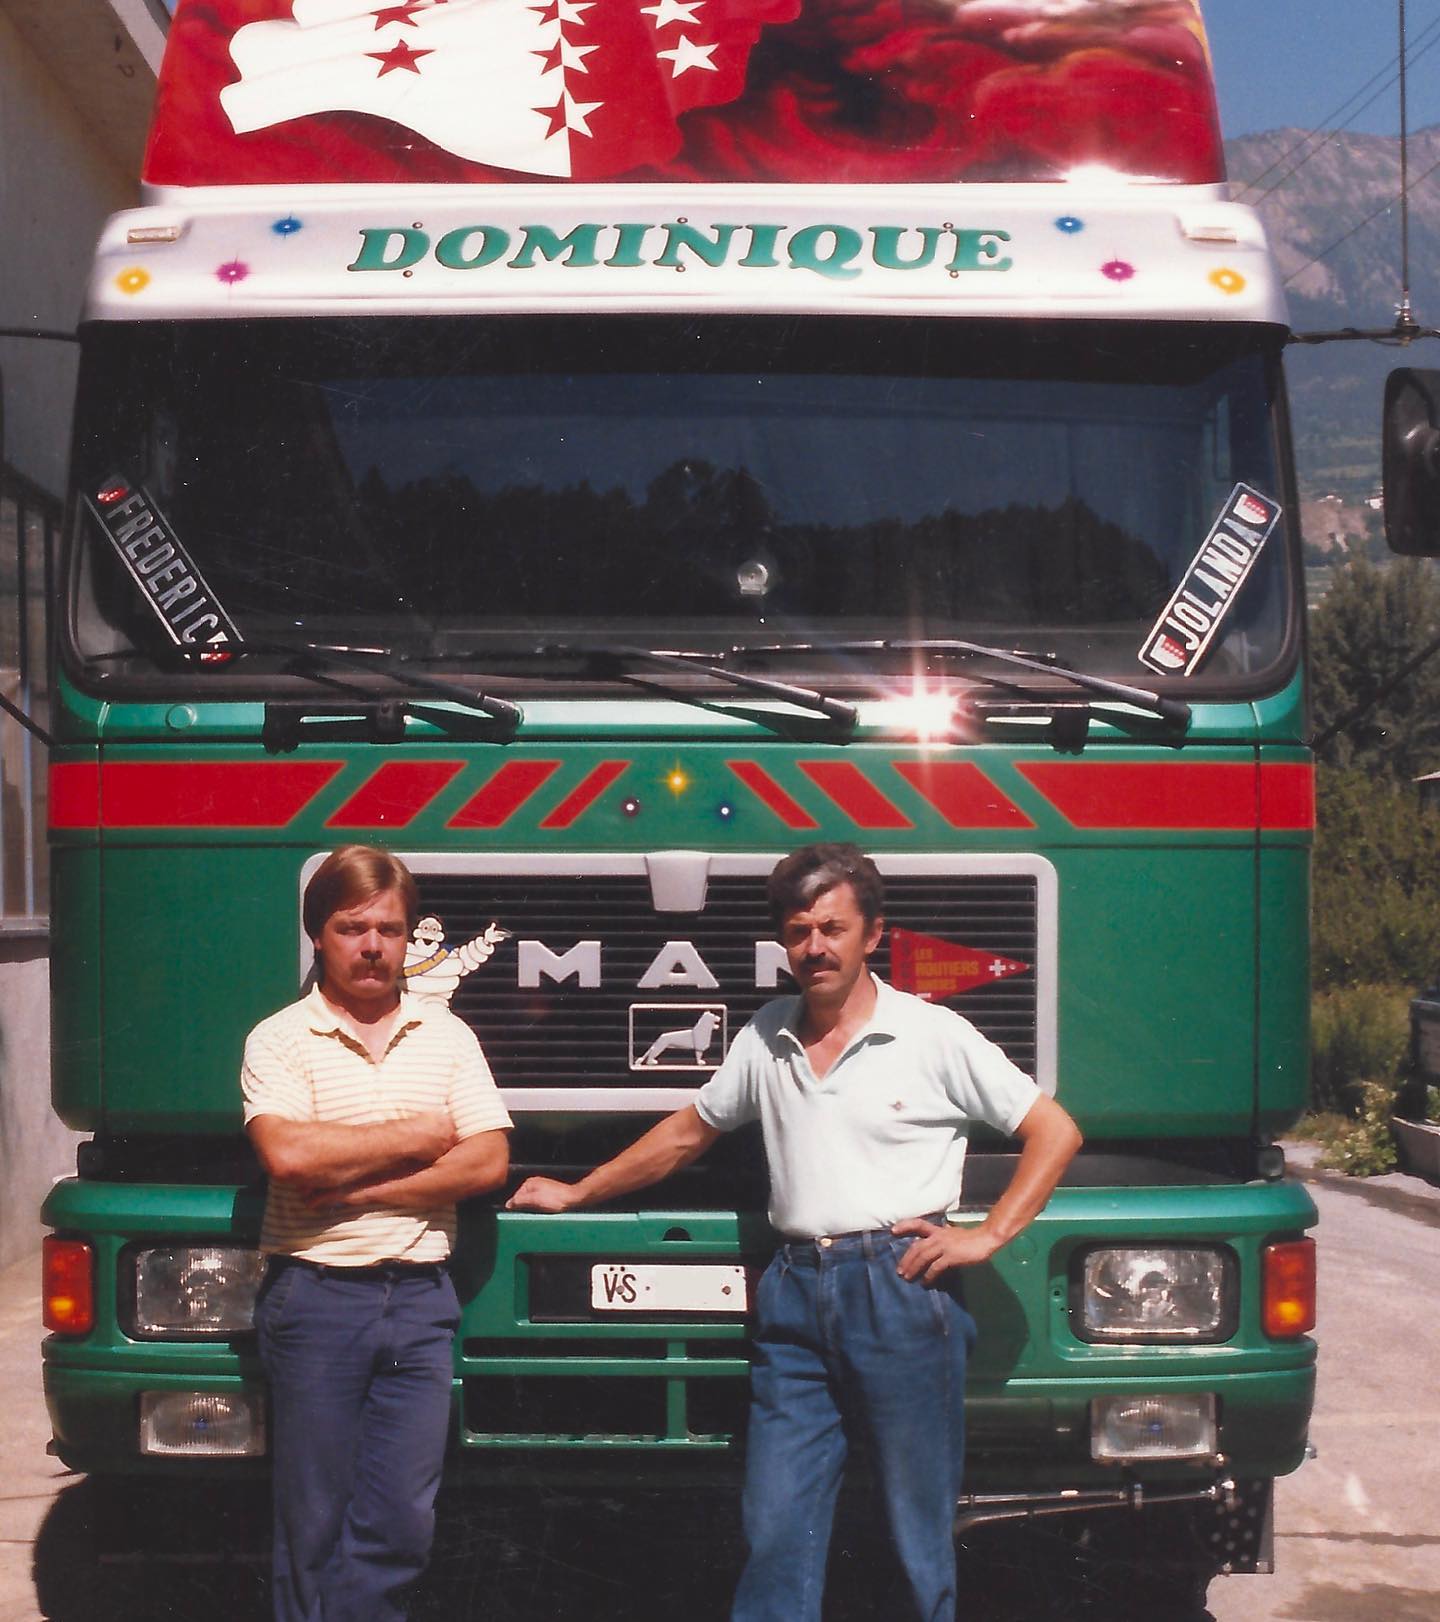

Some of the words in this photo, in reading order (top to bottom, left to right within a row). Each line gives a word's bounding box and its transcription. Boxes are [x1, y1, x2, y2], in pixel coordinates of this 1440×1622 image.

[347, 223, 1013, 279] DOMINIQUE
[1165, 518, 1263, 650] JOLANDA
[603, 1273, 637, 1303] VS
